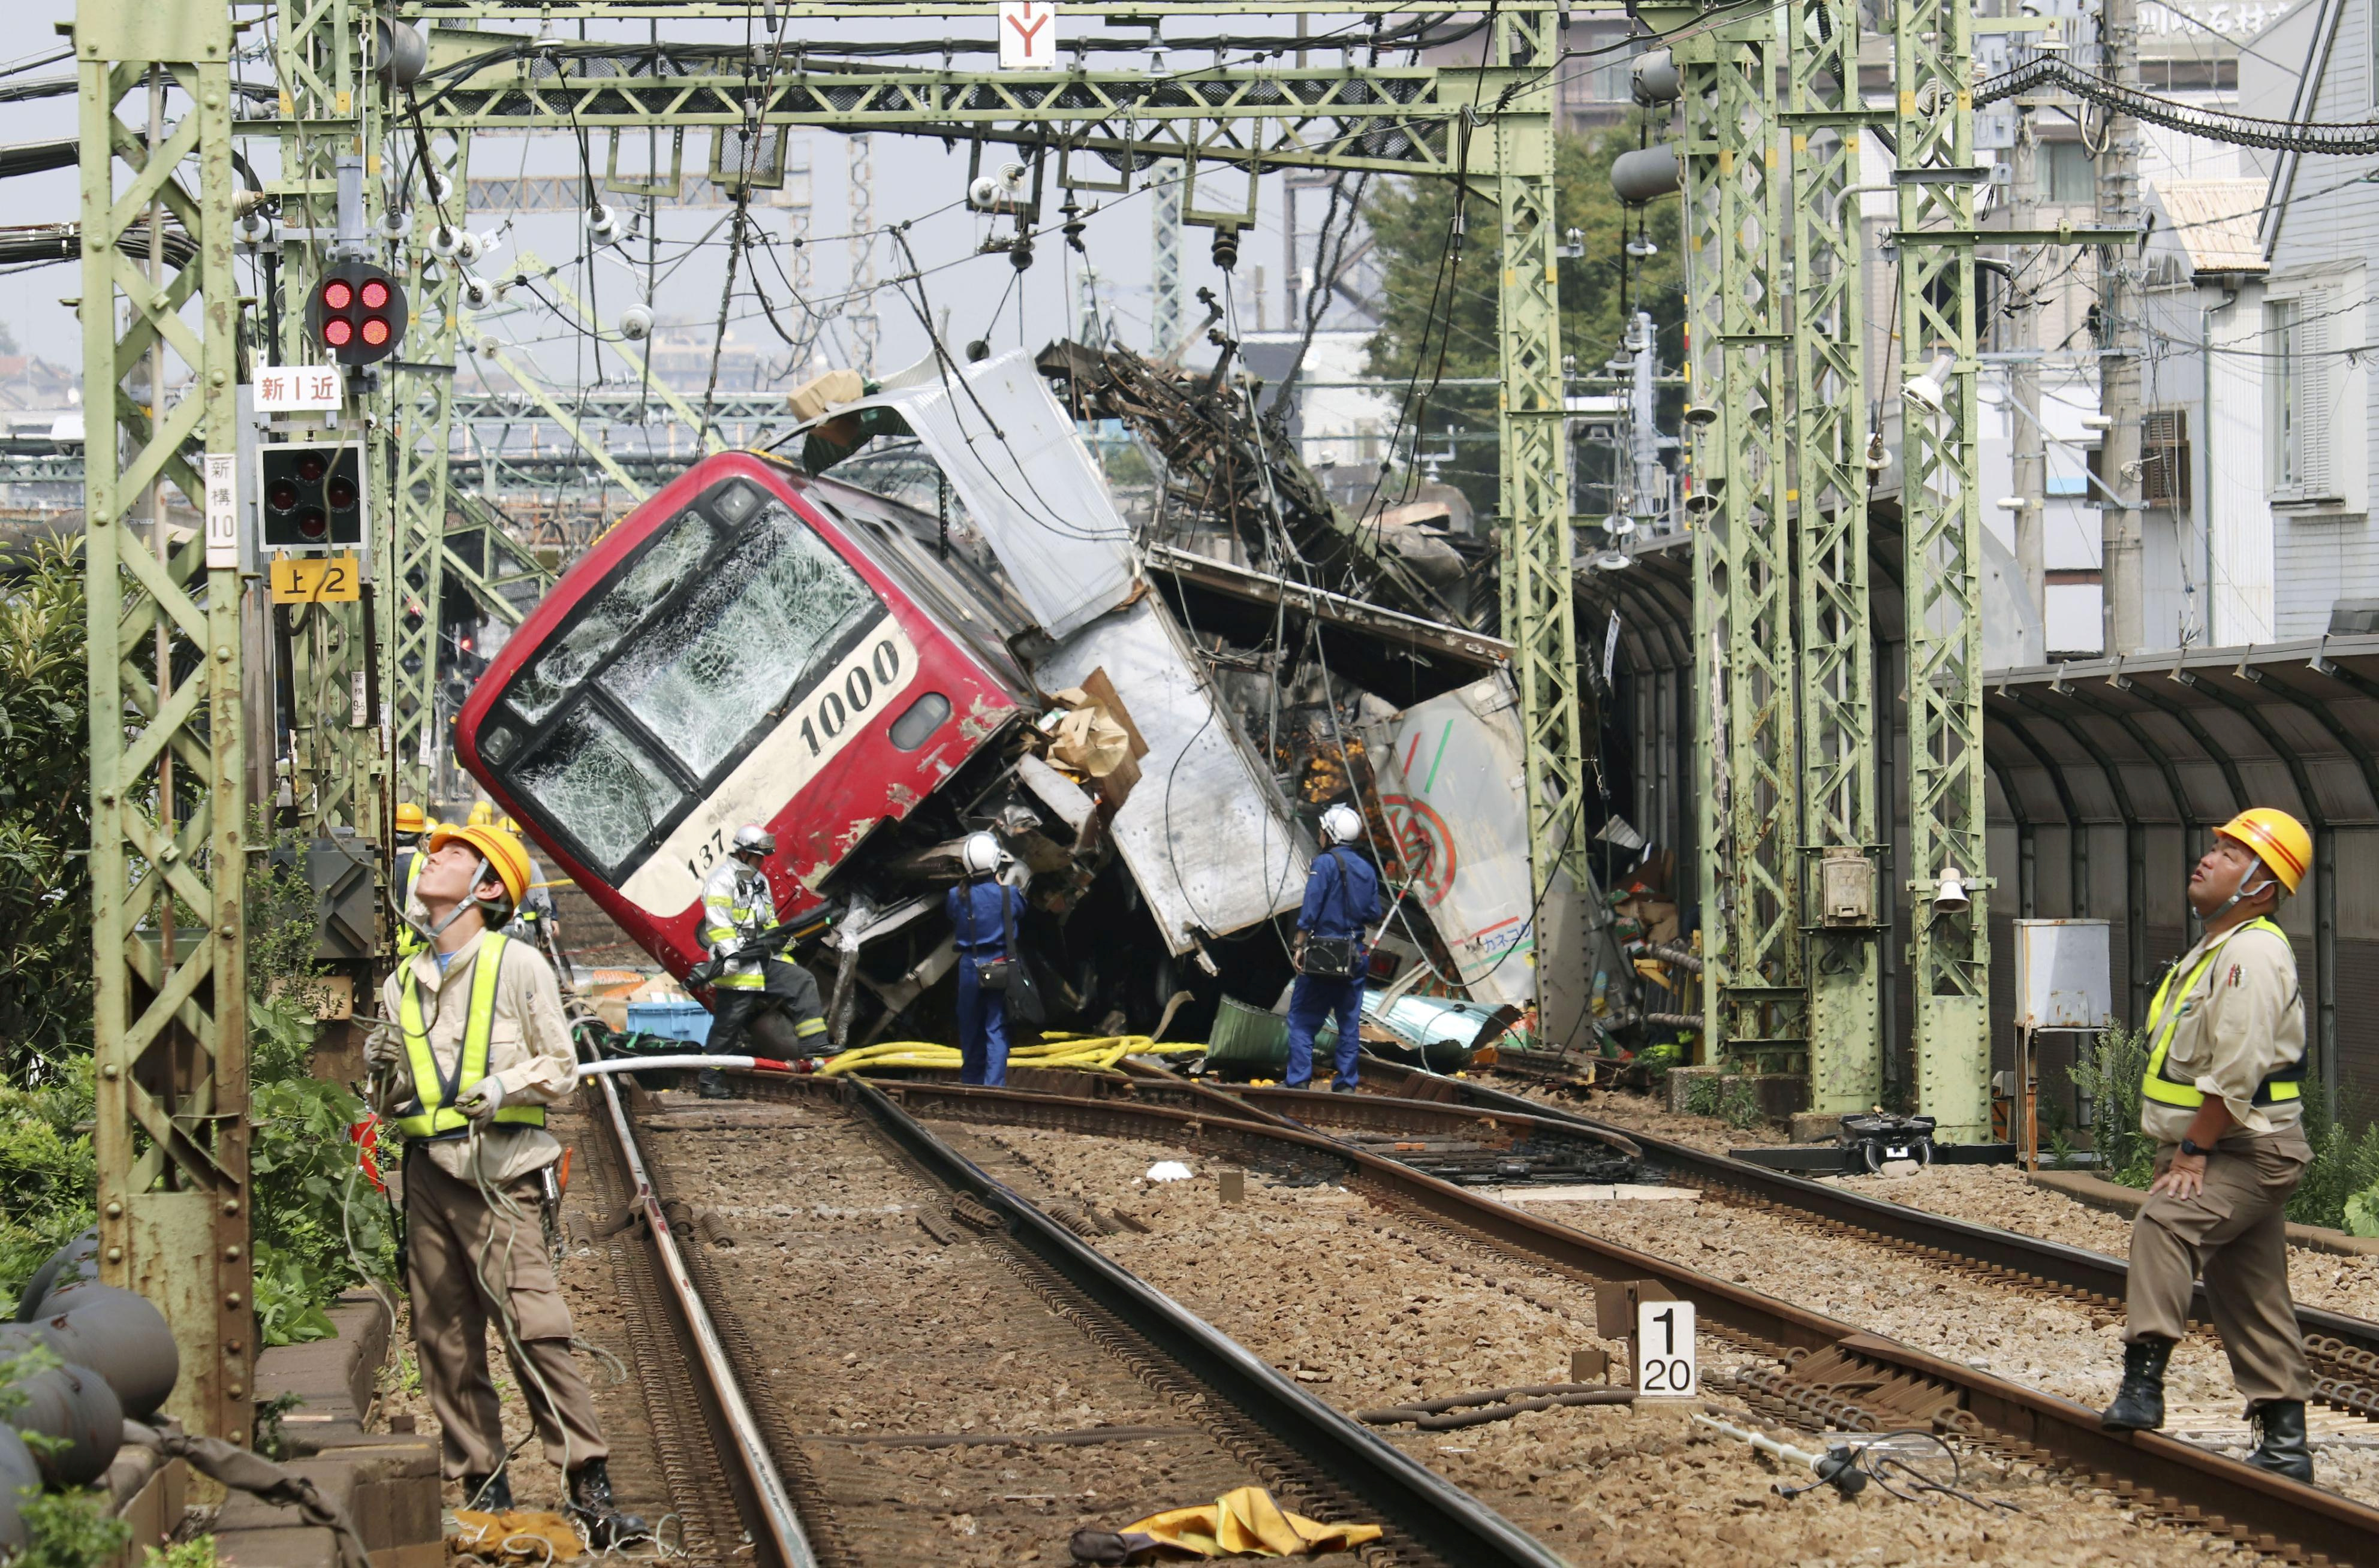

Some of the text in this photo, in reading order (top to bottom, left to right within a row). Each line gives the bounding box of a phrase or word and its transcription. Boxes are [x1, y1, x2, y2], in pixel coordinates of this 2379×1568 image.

[800, 640, 899, 758] 1000
[688, 827, 724, 881] 137
[1653, 1308, 1673, 1355] 1
[1645, 1359, 1690, 1391] 20
